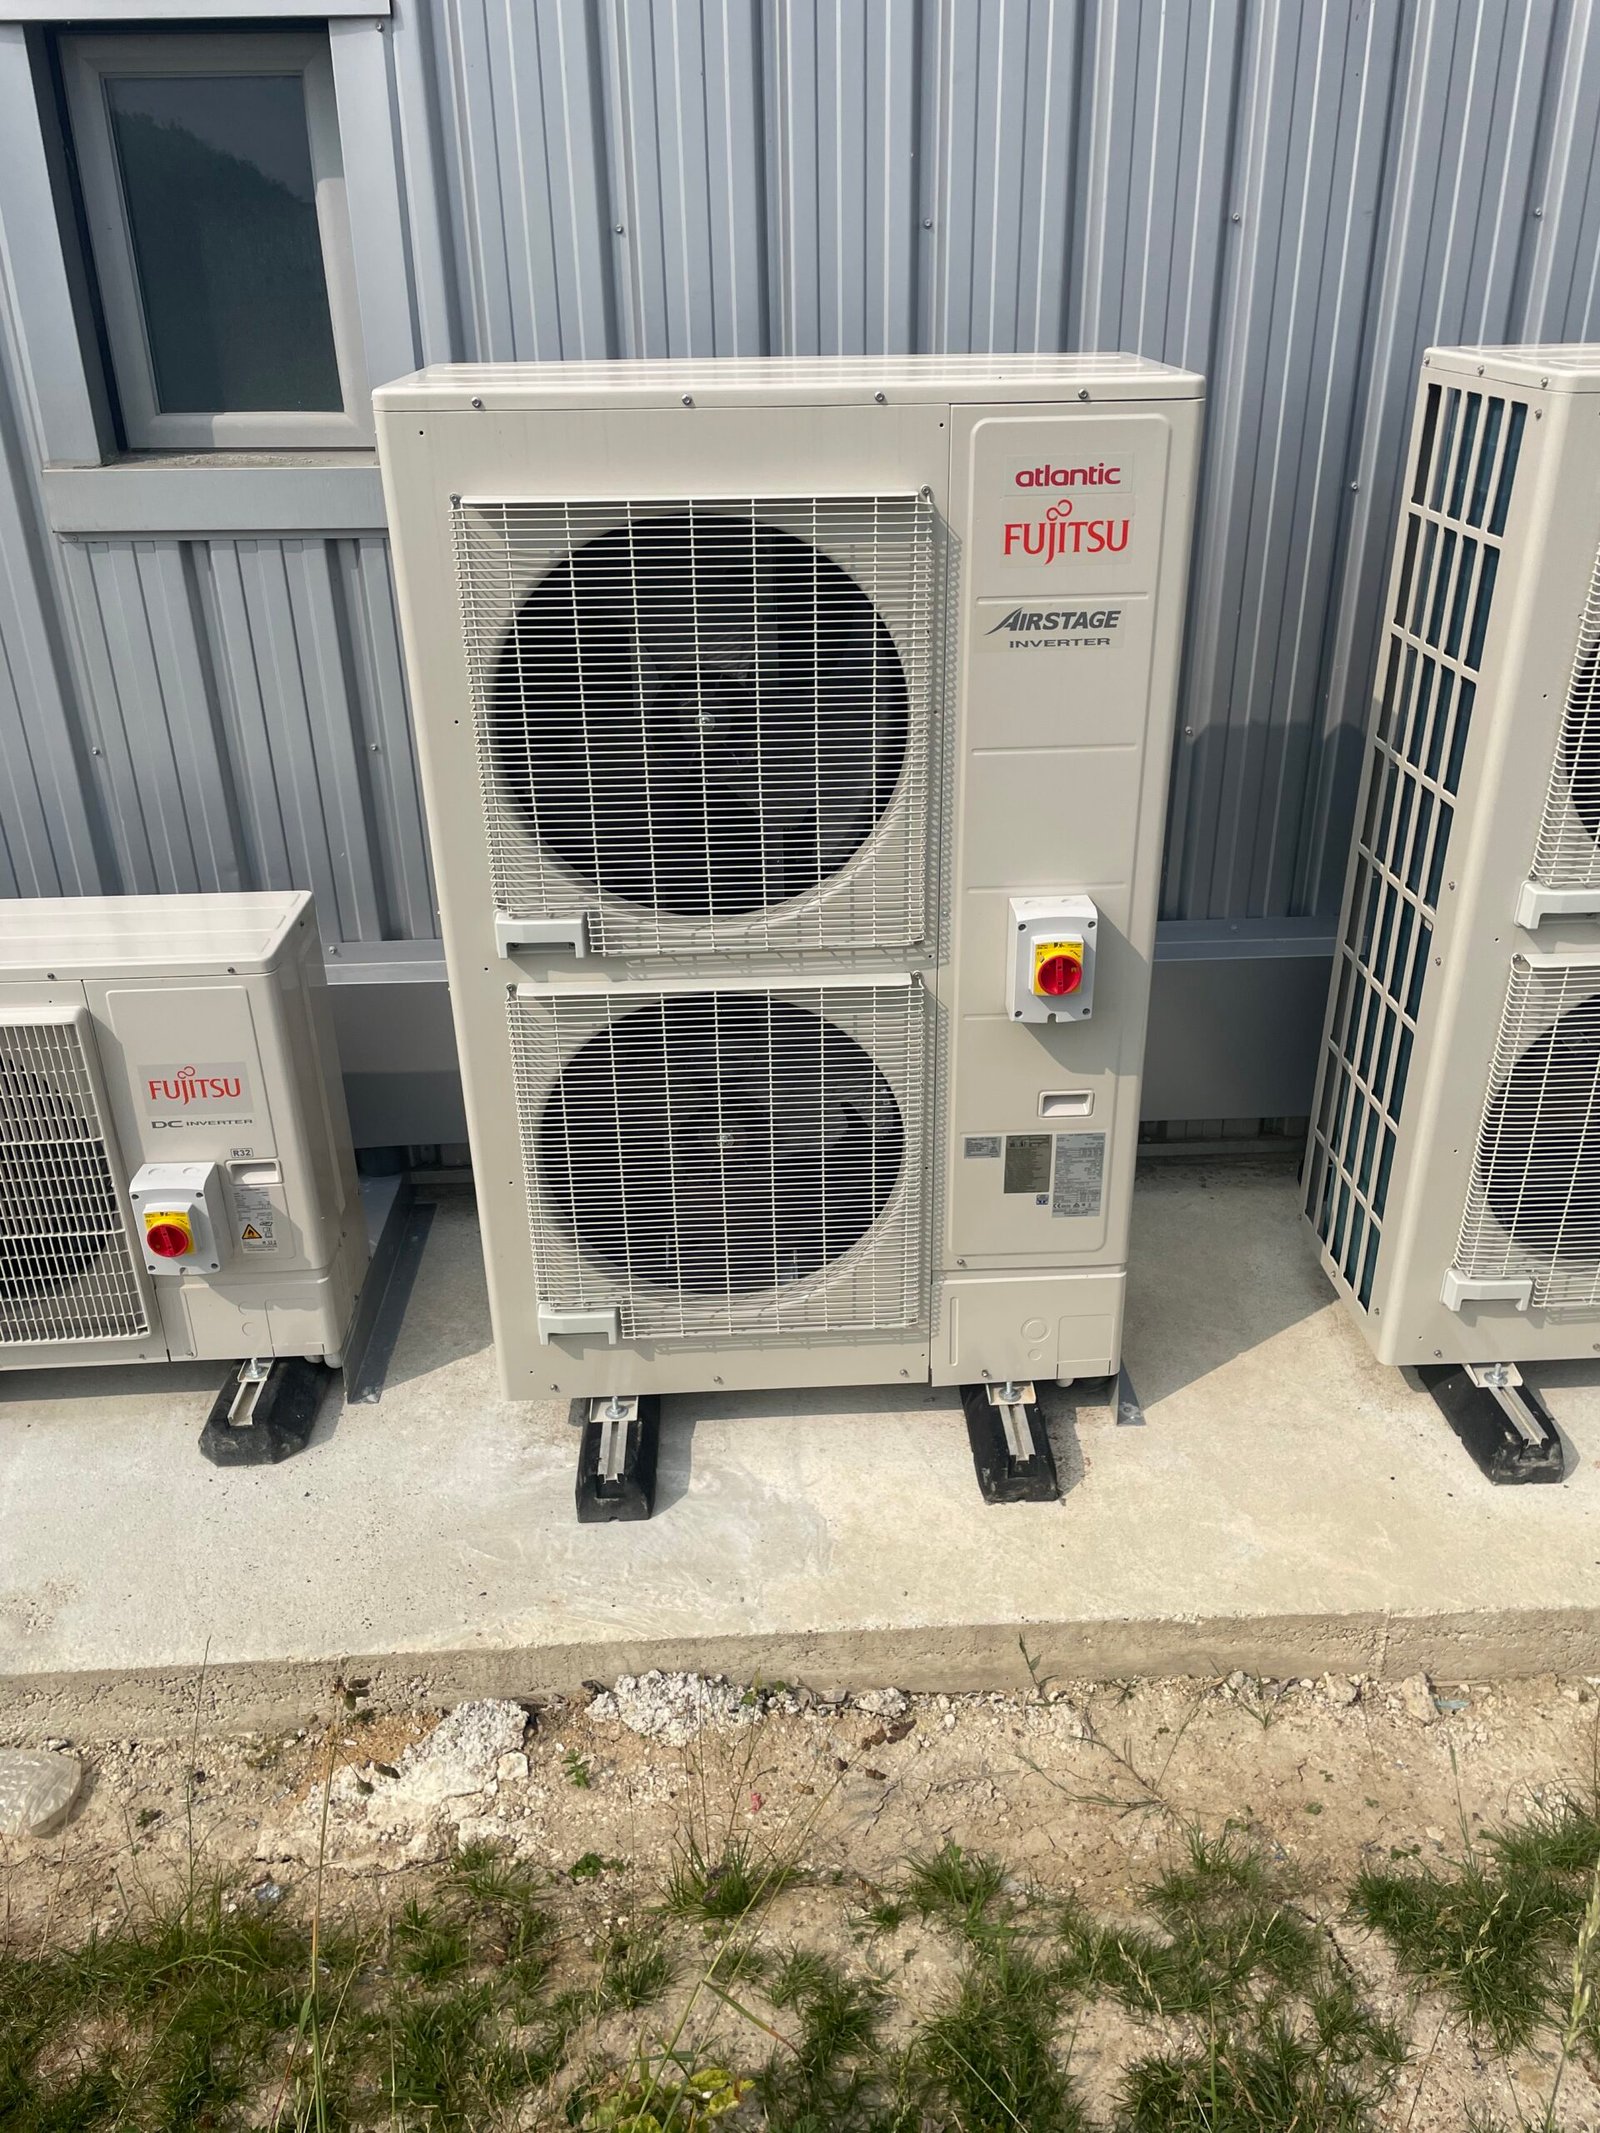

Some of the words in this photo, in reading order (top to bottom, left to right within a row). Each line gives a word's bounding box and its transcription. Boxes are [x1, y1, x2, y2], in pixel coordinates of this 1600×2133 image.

[1015, 462, 1121, 487] atlantic
[1003, 519, 1130, 566] FUJITSU
[984, 606, 1121, 636] AIRSTAGE
[1009, 637, 1110, 648] INVERTER
[148, 1077, 241, 1105] FUJITSU
[151, 1120, 184, 1129] DC
[186, 1119, 253, 1127] INVERTER
[232, 1149, 251, 1157] R32
